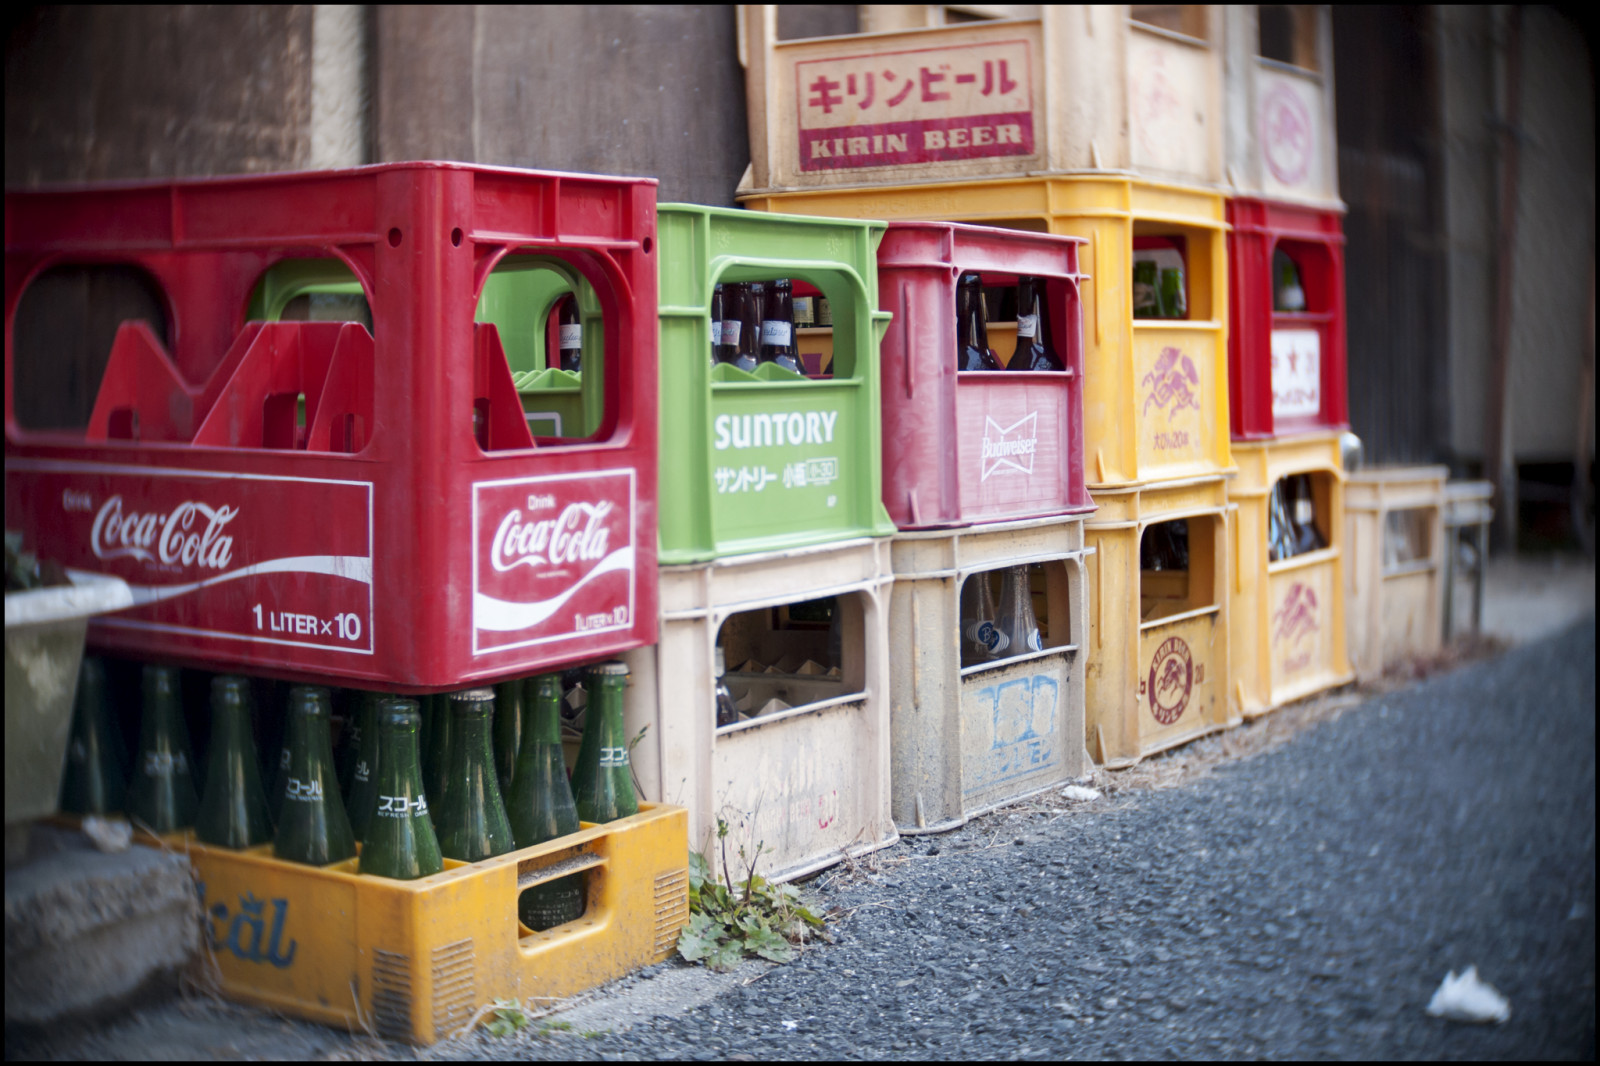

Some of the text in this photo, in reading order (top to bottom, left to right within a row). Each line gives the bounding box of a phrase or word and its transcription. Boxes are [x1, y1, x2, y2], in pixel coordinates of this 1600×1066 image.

[808, 58, 1018, 114] キリンビール
[810, 124, 1022, 159] KIRIN BEER
[714, 410, 838, 450] SUNTORY
[982, 434, 1037, 459] Budweiser
[714, 465, 778, 494] サントリー
[528, 494, 555, 511] Drink
[91, 494, 240, 570] Coca-Cola
[491, 500, 614, 572] Coca-Cola
[379, 795, 427, 811] スコール
